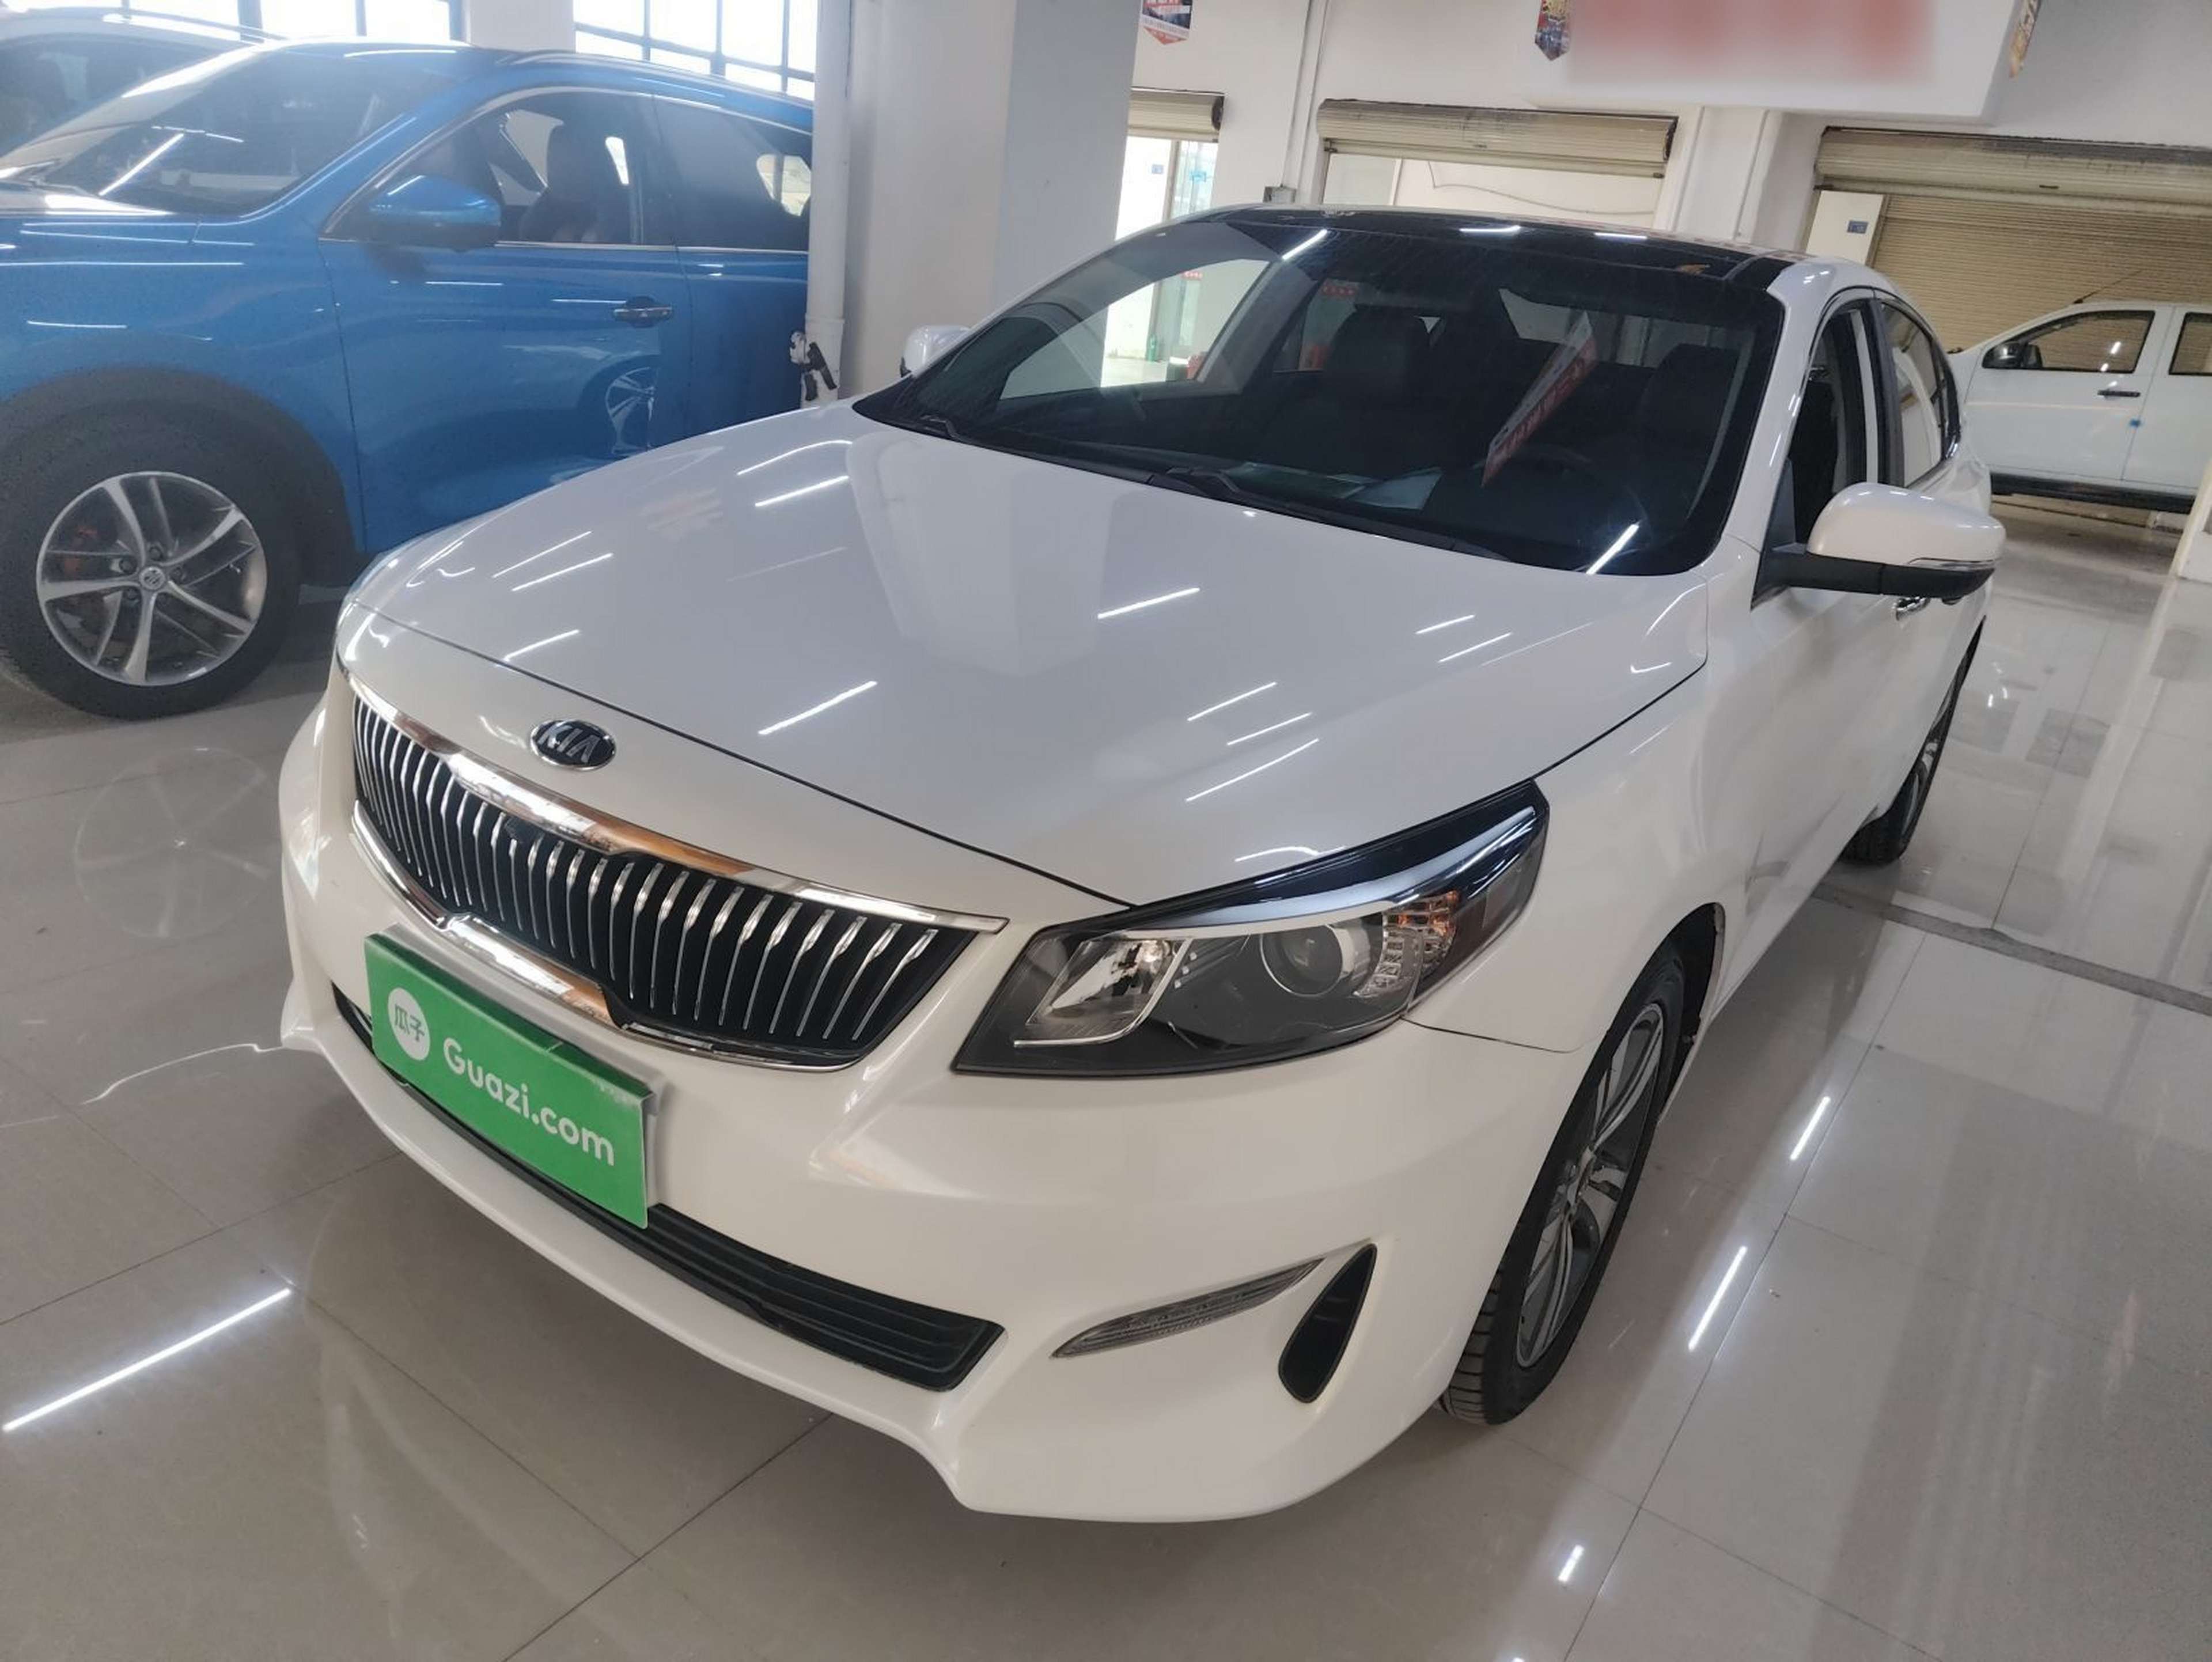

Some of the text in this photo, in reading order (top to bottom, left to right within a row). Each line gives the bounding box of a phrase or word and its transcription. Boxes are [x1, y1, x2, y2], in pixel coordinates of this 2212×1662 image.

[538, 725, 601, 763] KIA
[394, 1003, 425, 1042] 瓜子
[443, 1038, 615, 1166] Guazi.com
